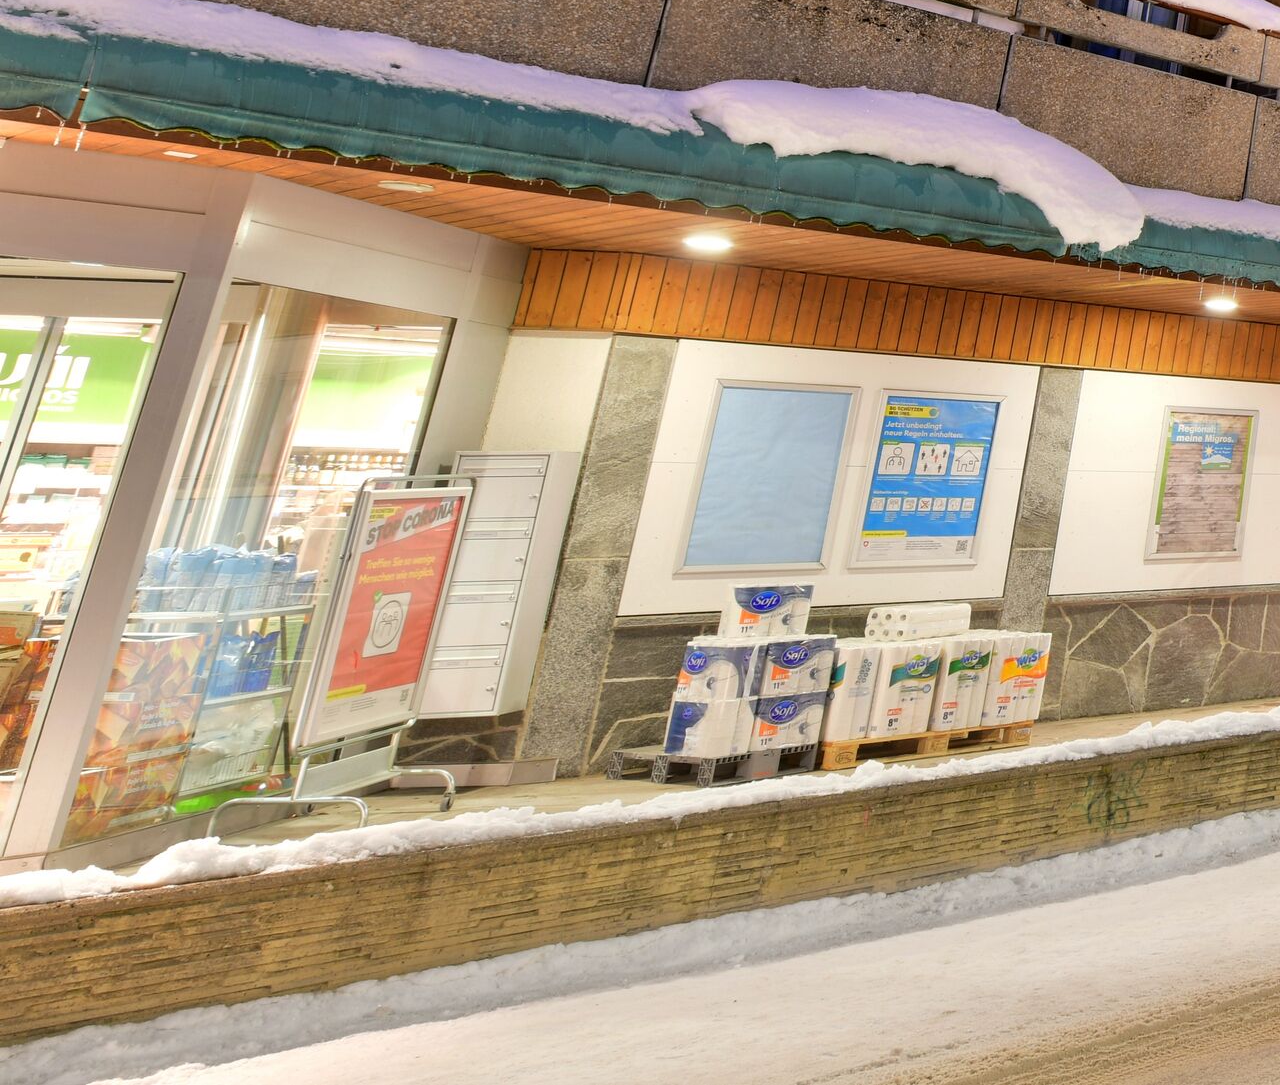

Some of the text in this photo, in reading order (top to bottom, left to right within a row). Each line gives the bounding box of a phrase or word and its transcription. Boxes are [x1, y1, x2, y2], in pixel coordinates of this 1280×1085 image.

[885, 420, 942, 430] Jetzt unbedingt
[1177, 424, 1217, 434] Regional:
[903, 430, 928, 438] Regeln
[1176, 434, 1235, 444] meine Migros.
[366, 500, 455, 546] STOP CORONA
[752, 593, 778, 609] Soft
[783, 647, 806, 663] Soft
[687, 656, 706, 670] Soft
[771, 702, 797, 720] Soft
